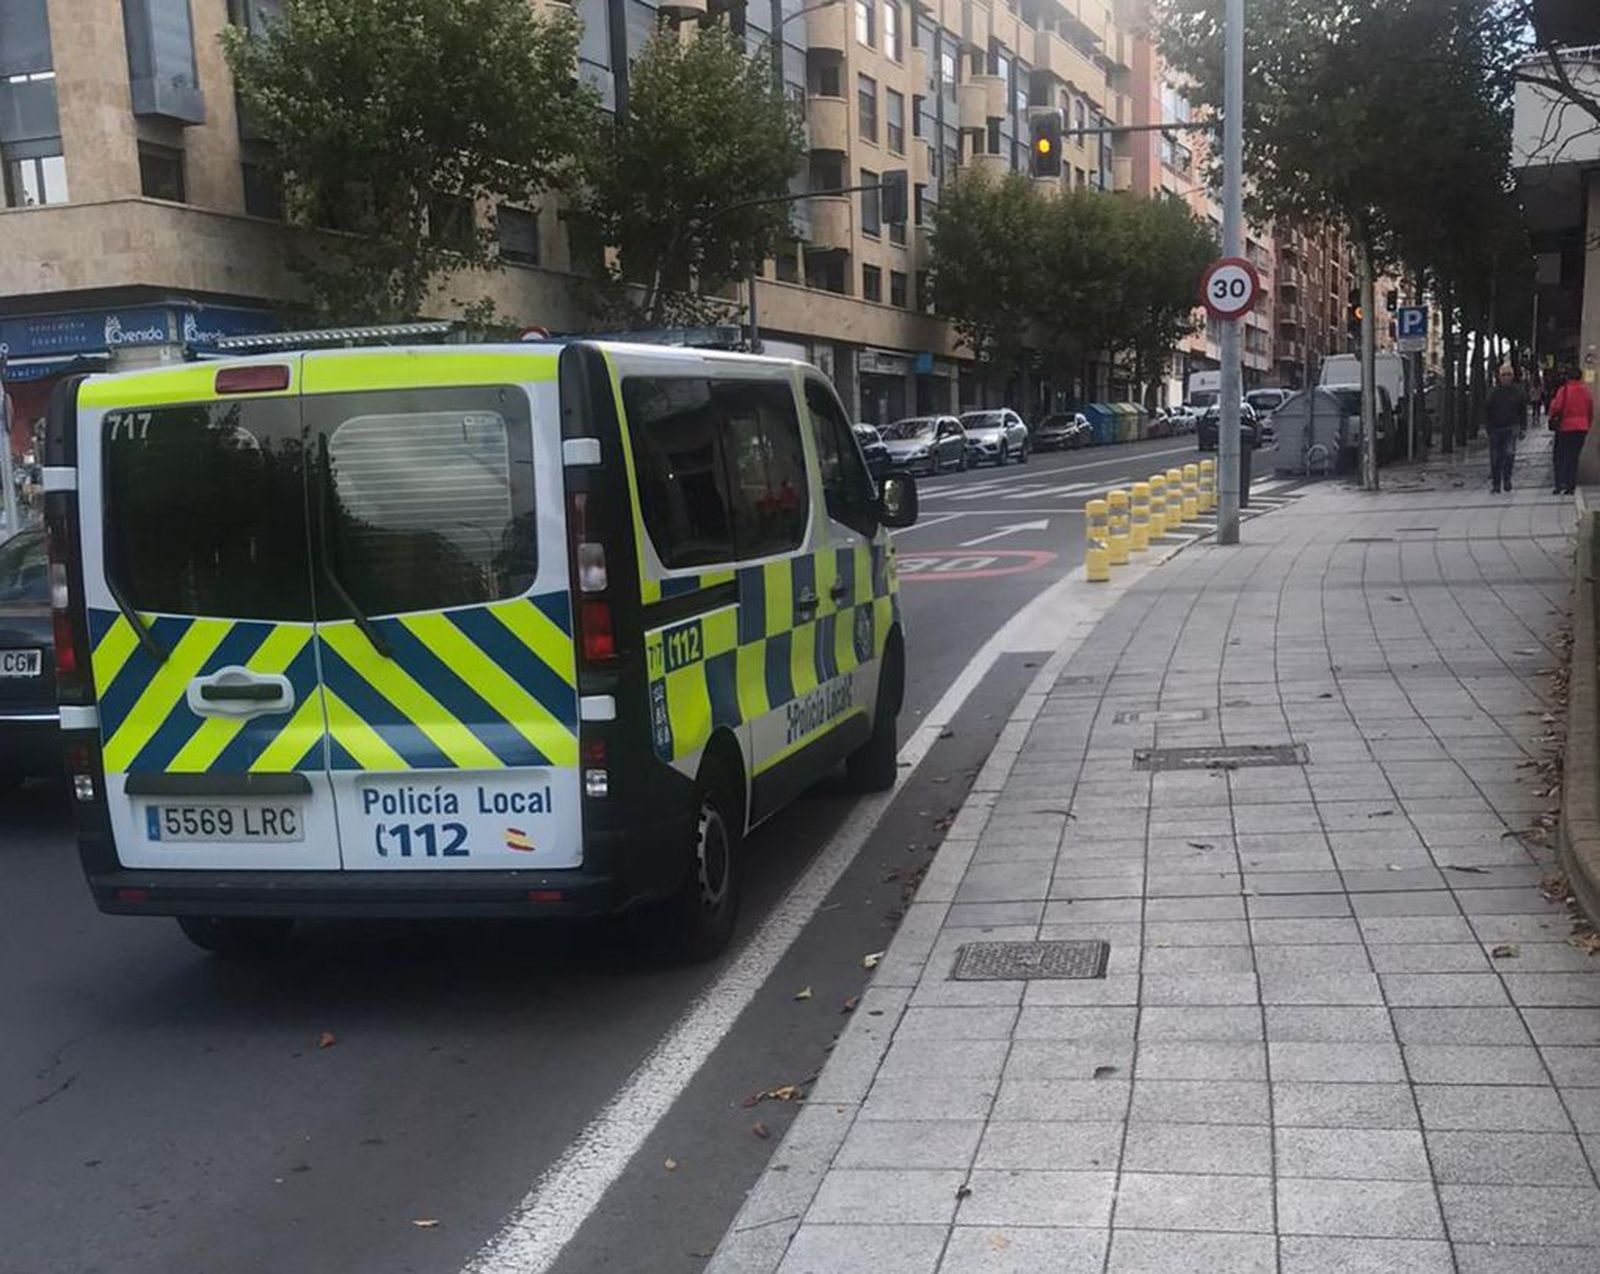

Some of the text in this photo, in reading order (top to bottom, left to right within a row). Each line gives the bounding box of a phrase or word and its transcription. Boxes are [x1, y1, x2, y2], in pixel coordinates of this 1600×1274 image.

[1213, 278, 1245, 299] 30
[1404, 310, 1423, 334] P
[108, 414, 151, 440] 717
[673, 627, 700, 666] 112
[363, 786, 552, 815] Policía Local
[165, 808, 296, 835] 5569 LRC
[388, 822, 470, 858] 112
